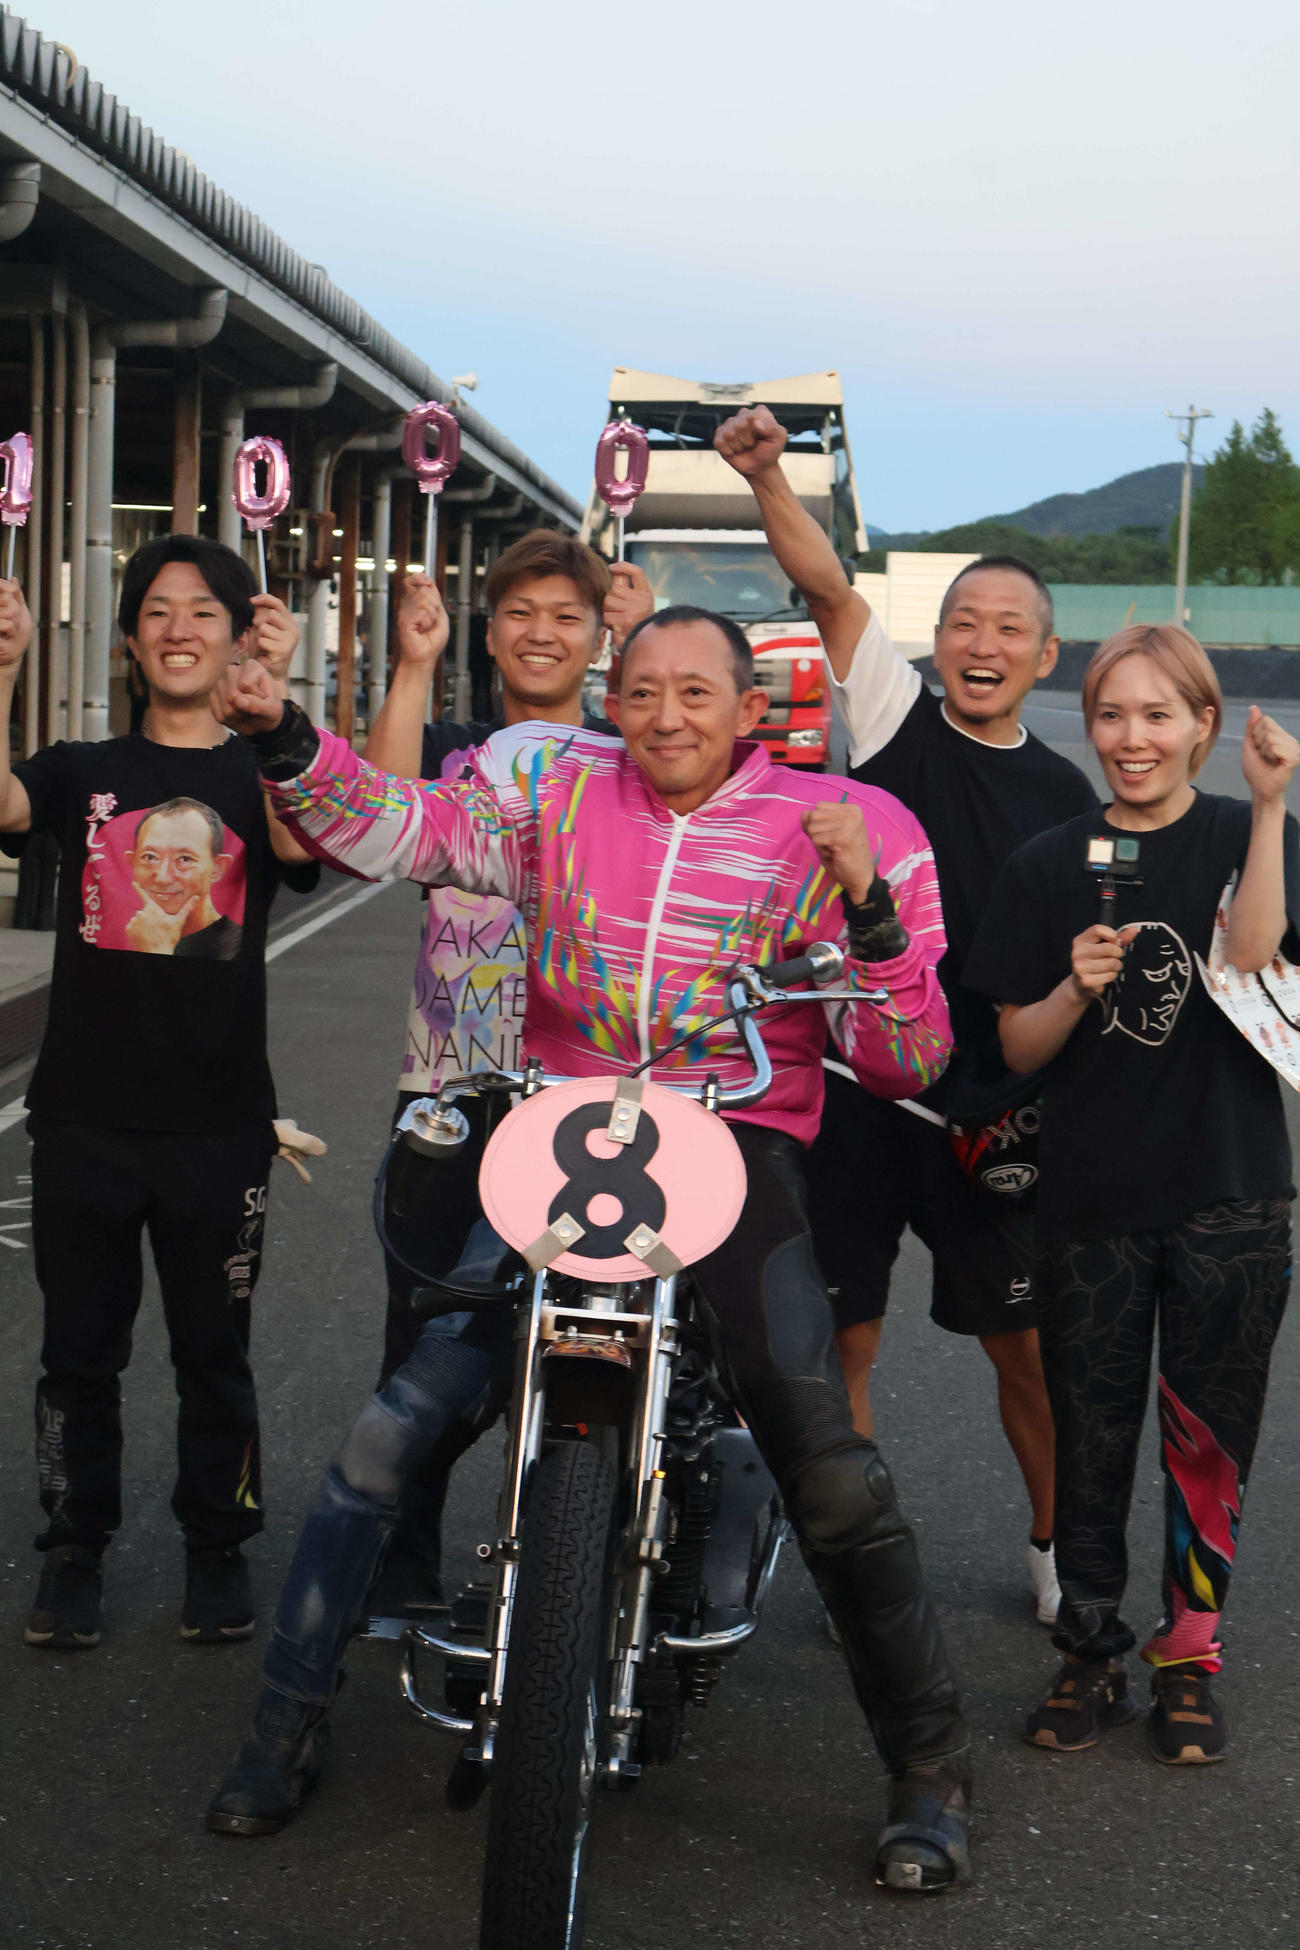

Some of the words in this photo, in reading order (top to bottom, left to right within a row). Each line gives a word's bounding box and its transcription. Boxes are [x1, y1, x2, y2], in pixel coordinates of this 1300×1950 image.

[0, 432, 34, 512] 1
[232, 435, 290, 517] 0
[402, 401, 461, 482] 0
[595, 421, 650, 504] 0
[430, 916, 525, 961] AKA
[547, 1100, 667, 1260] 8
